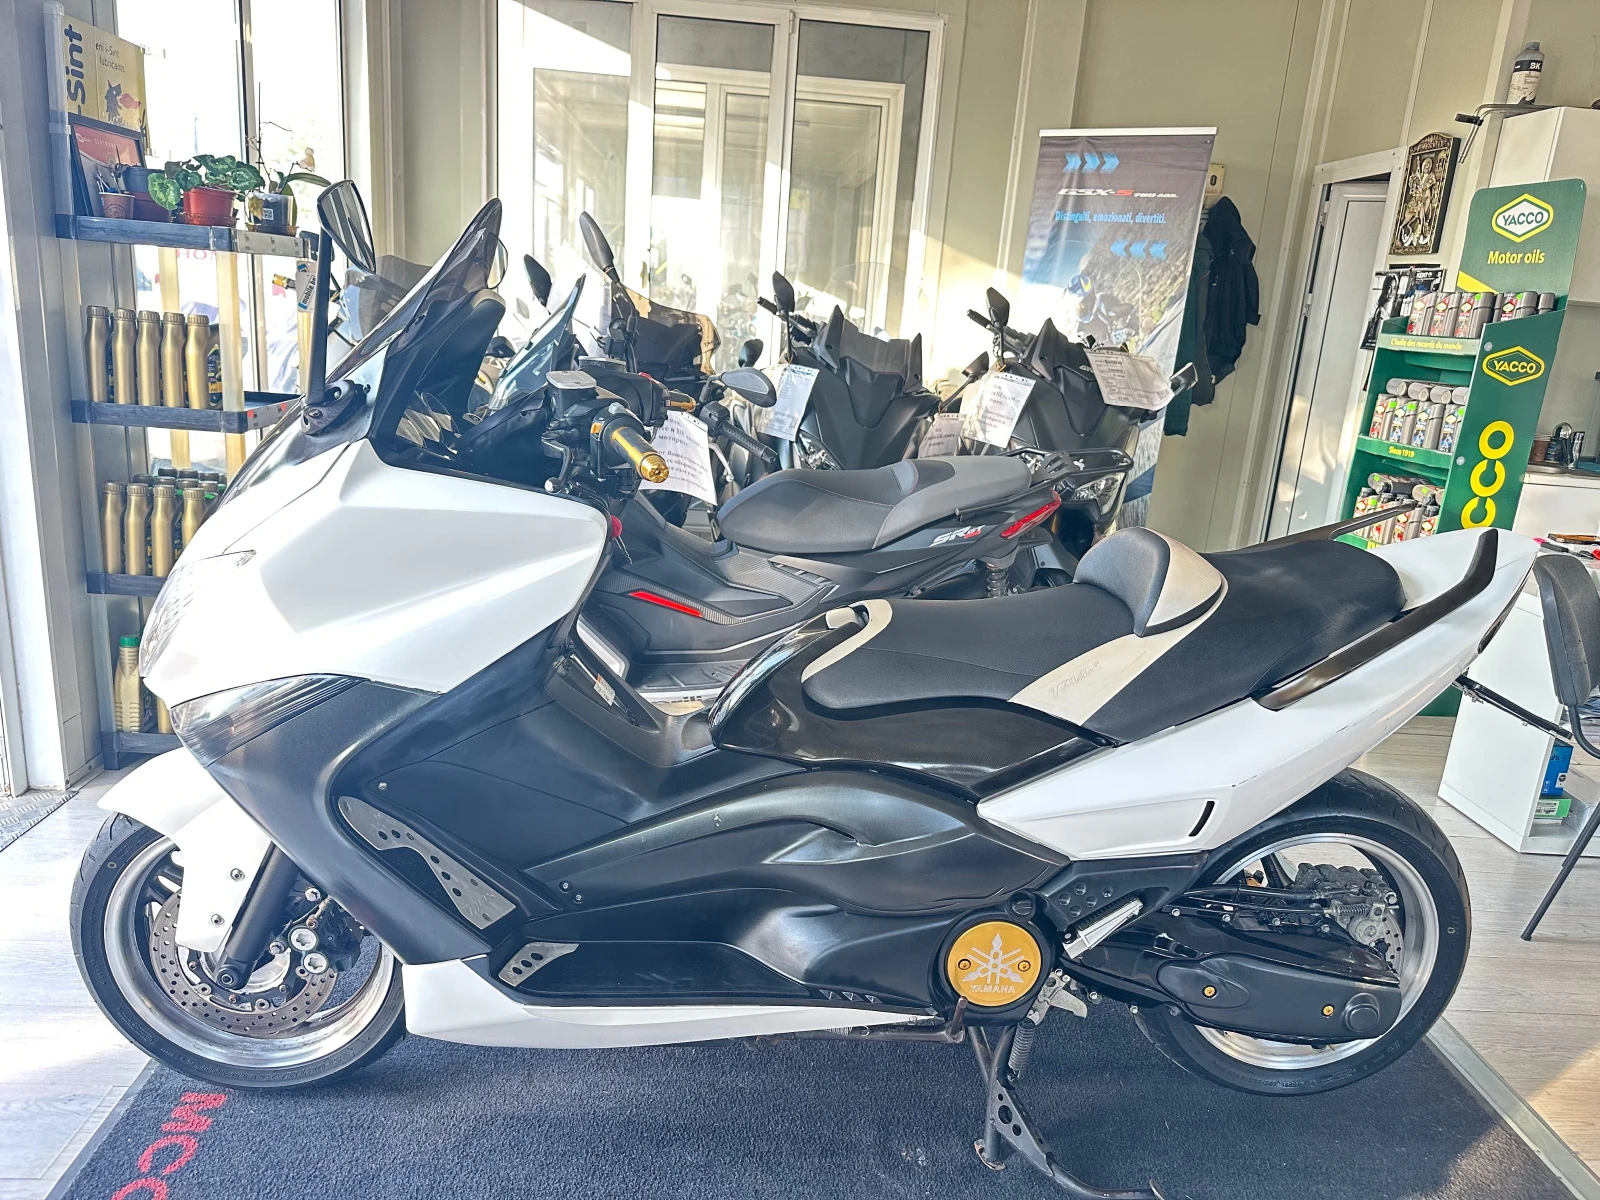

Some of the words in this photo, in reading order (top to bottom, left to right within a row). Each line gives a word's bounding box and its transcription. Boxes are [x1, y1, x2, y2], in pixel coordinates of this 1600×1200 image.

[99, 54, 126, 73] lubricants
[1530, 61, 1541, 70] BK
[1055, 210, 1092, 224] Distinguiti,
[1093, 211, 1134, 225] emozionati,
[1135, 212, 1166, 224] divertiti.
[1502, 210, 1544, 227] YACCO
[1487, 250, 1523, 265] Motor
[1524, 248, 1545, 264] oils
[1390, 337, 1407, 346] L'huile
[1406, 339, 1416, 347] des
[1416, 340, 1436, 348] records
[1435, 341, 1443, 349] du
[1443, 342, 1463, 351] monde
[1494, 360, 1536, 374] YACCO
[1388, 445, 1402, 456] Since
[1401, 448, 1415, 458] 1919
[969, 984, 1016, 994] YAMAHA
